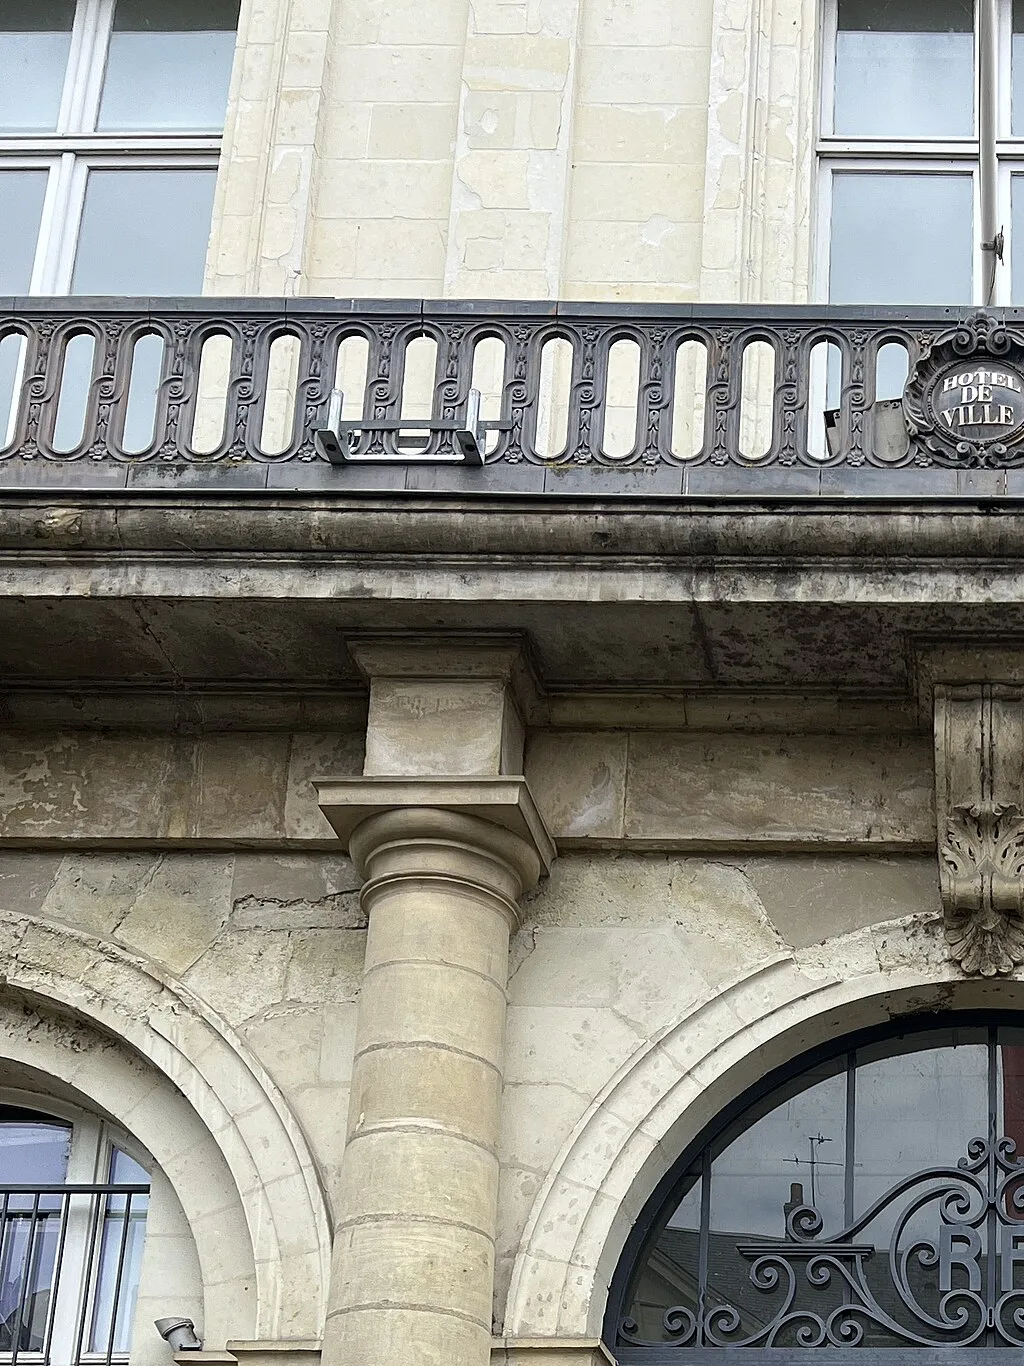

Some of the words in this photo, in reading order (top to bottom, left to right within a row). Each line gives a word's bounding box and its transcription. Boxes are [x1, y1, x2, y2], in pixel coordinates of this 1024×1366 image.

[942, 371, 1021, 394] HOTEL
[960, 384, 993, 404] DE
[940, 404, 1015, 427] VILLE
